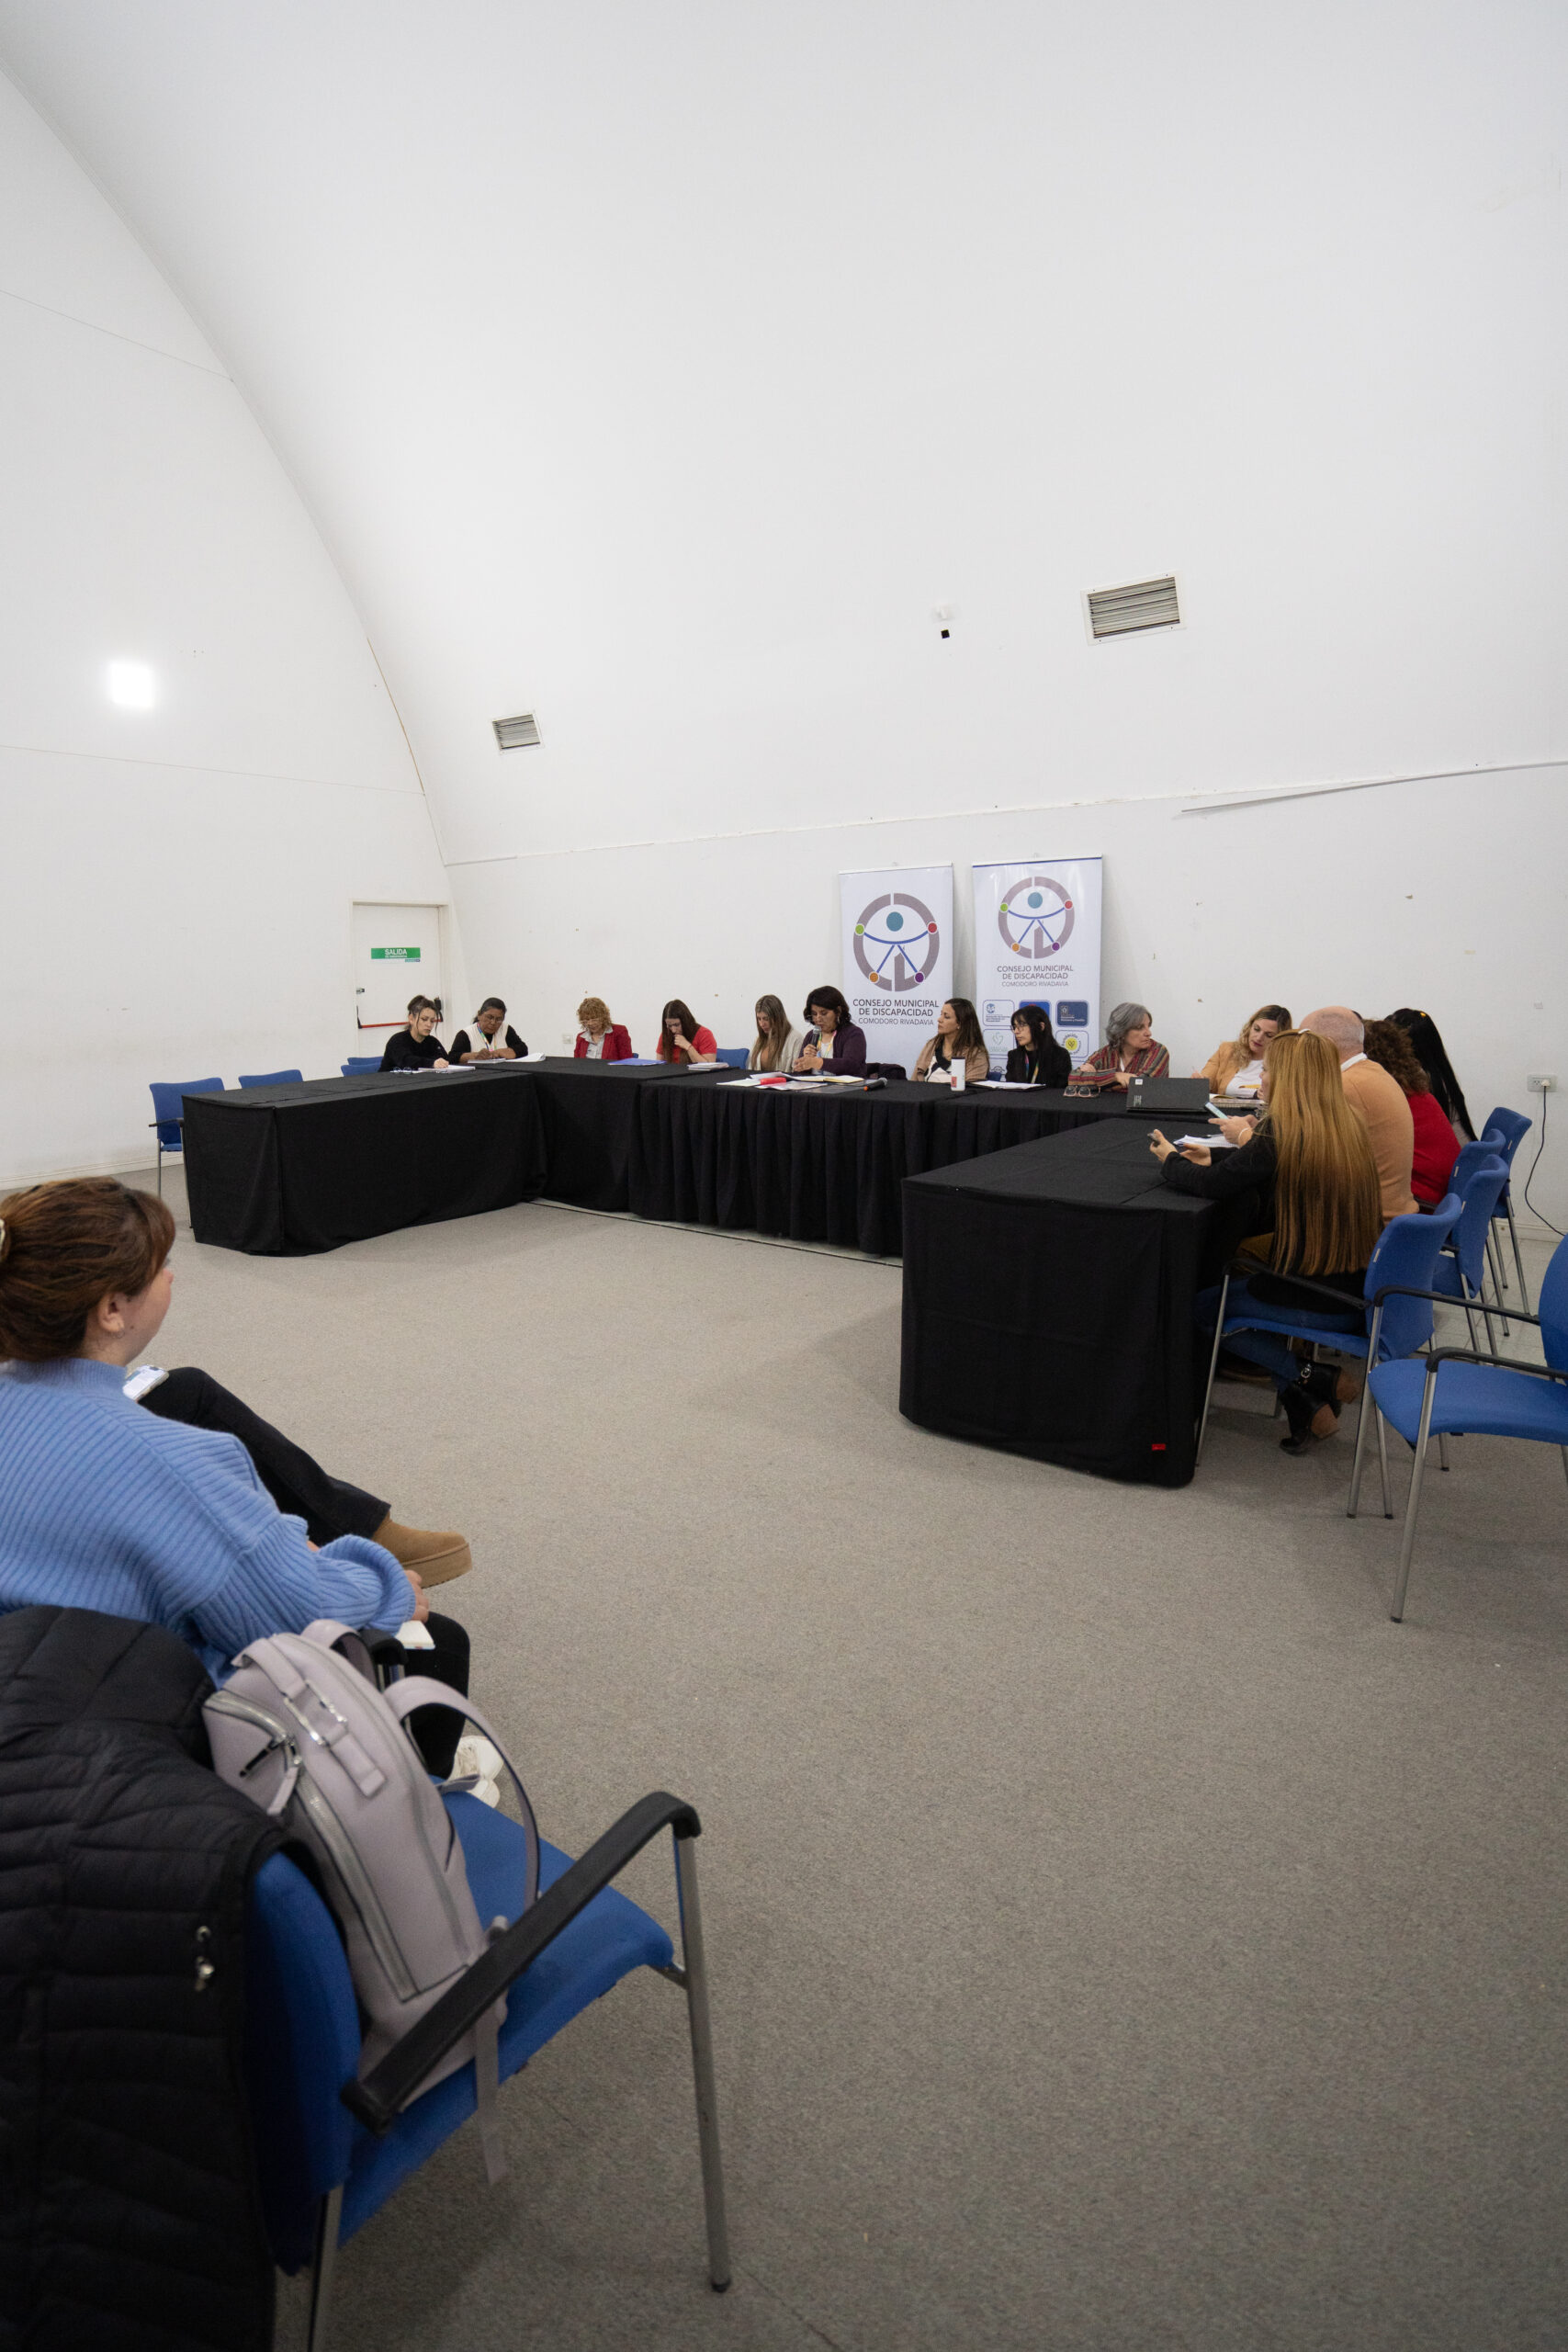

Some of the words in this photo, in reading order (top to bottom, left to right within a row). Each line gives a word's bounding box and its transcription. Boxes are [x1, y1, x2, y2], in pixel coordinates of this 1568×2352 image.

[852, 999, 892, 1007] CONSEJO
[894, 1000, 939, 1008] MUNICIPAL
[873, 1008, 933, 1016] DISCAPACIDAD
